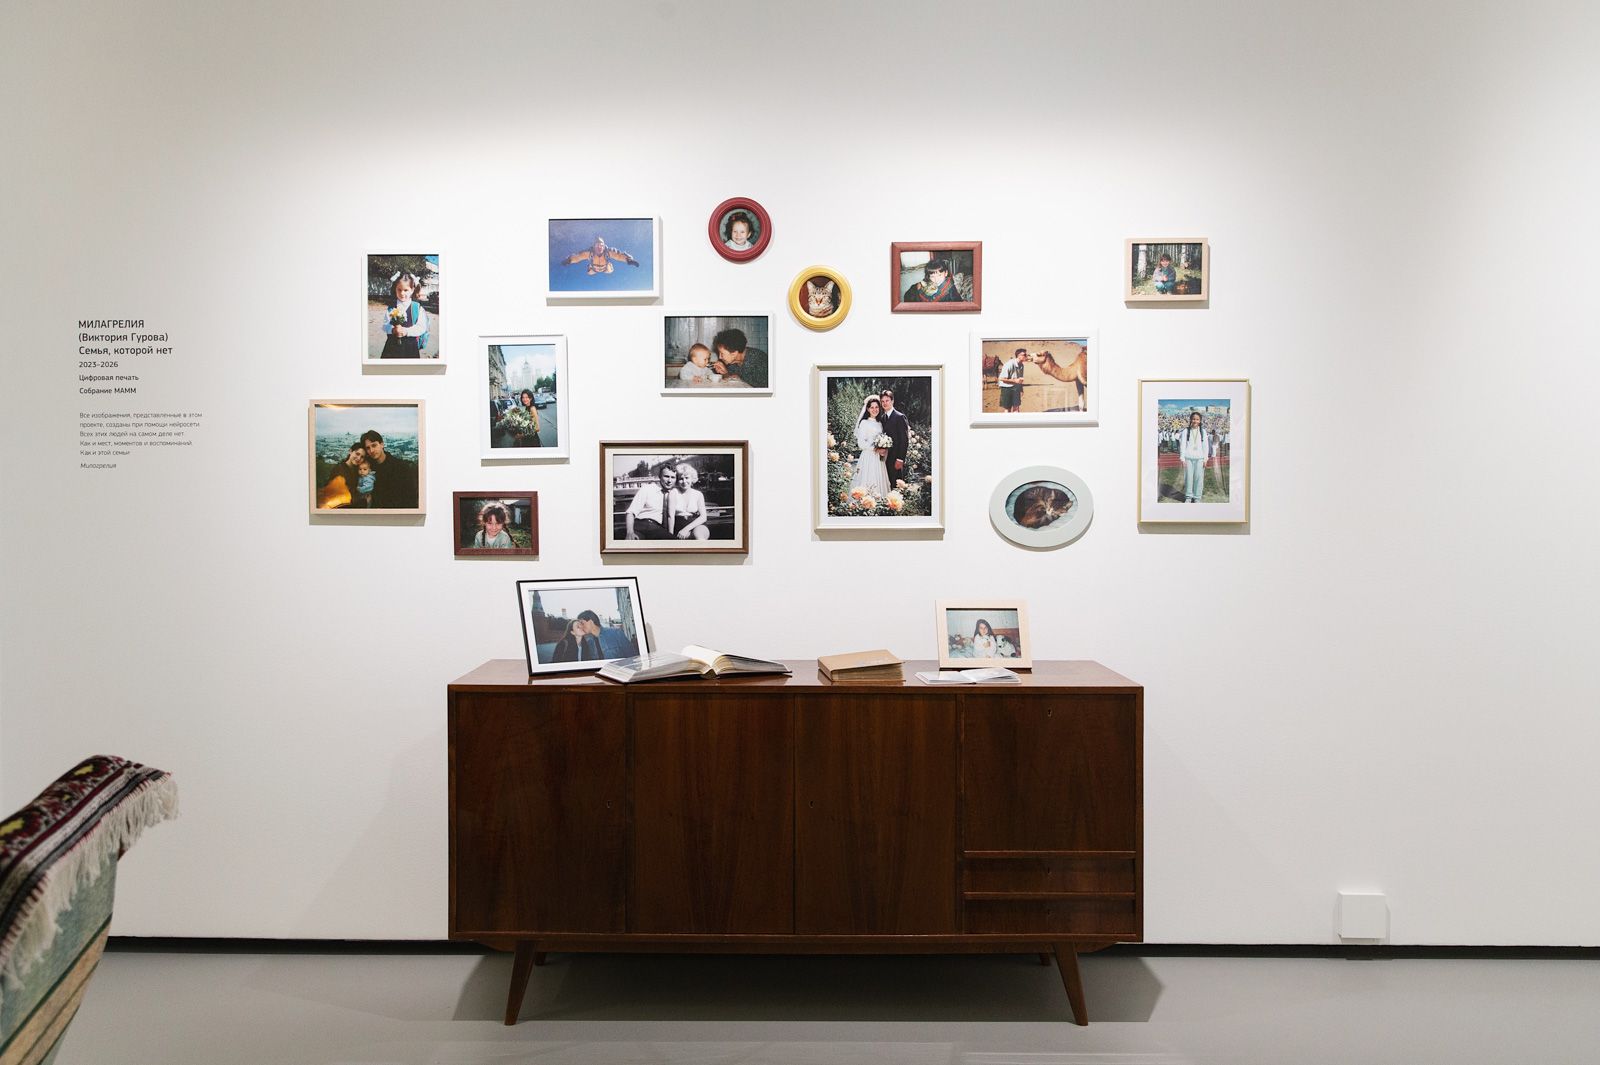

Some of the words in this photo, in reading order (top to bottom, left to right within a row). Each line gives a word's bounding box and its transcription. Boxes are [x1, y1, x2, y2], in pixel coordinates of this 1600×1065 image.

[79, 320, 144, 328] МИЛАГРЕЛИЯ
[78, 333, 128, 343] (Виктория
[131, 333, 168, 343] Гурова)
[79, 346, 111, 355] Семья,
[114, 346, 153, 356] которой
